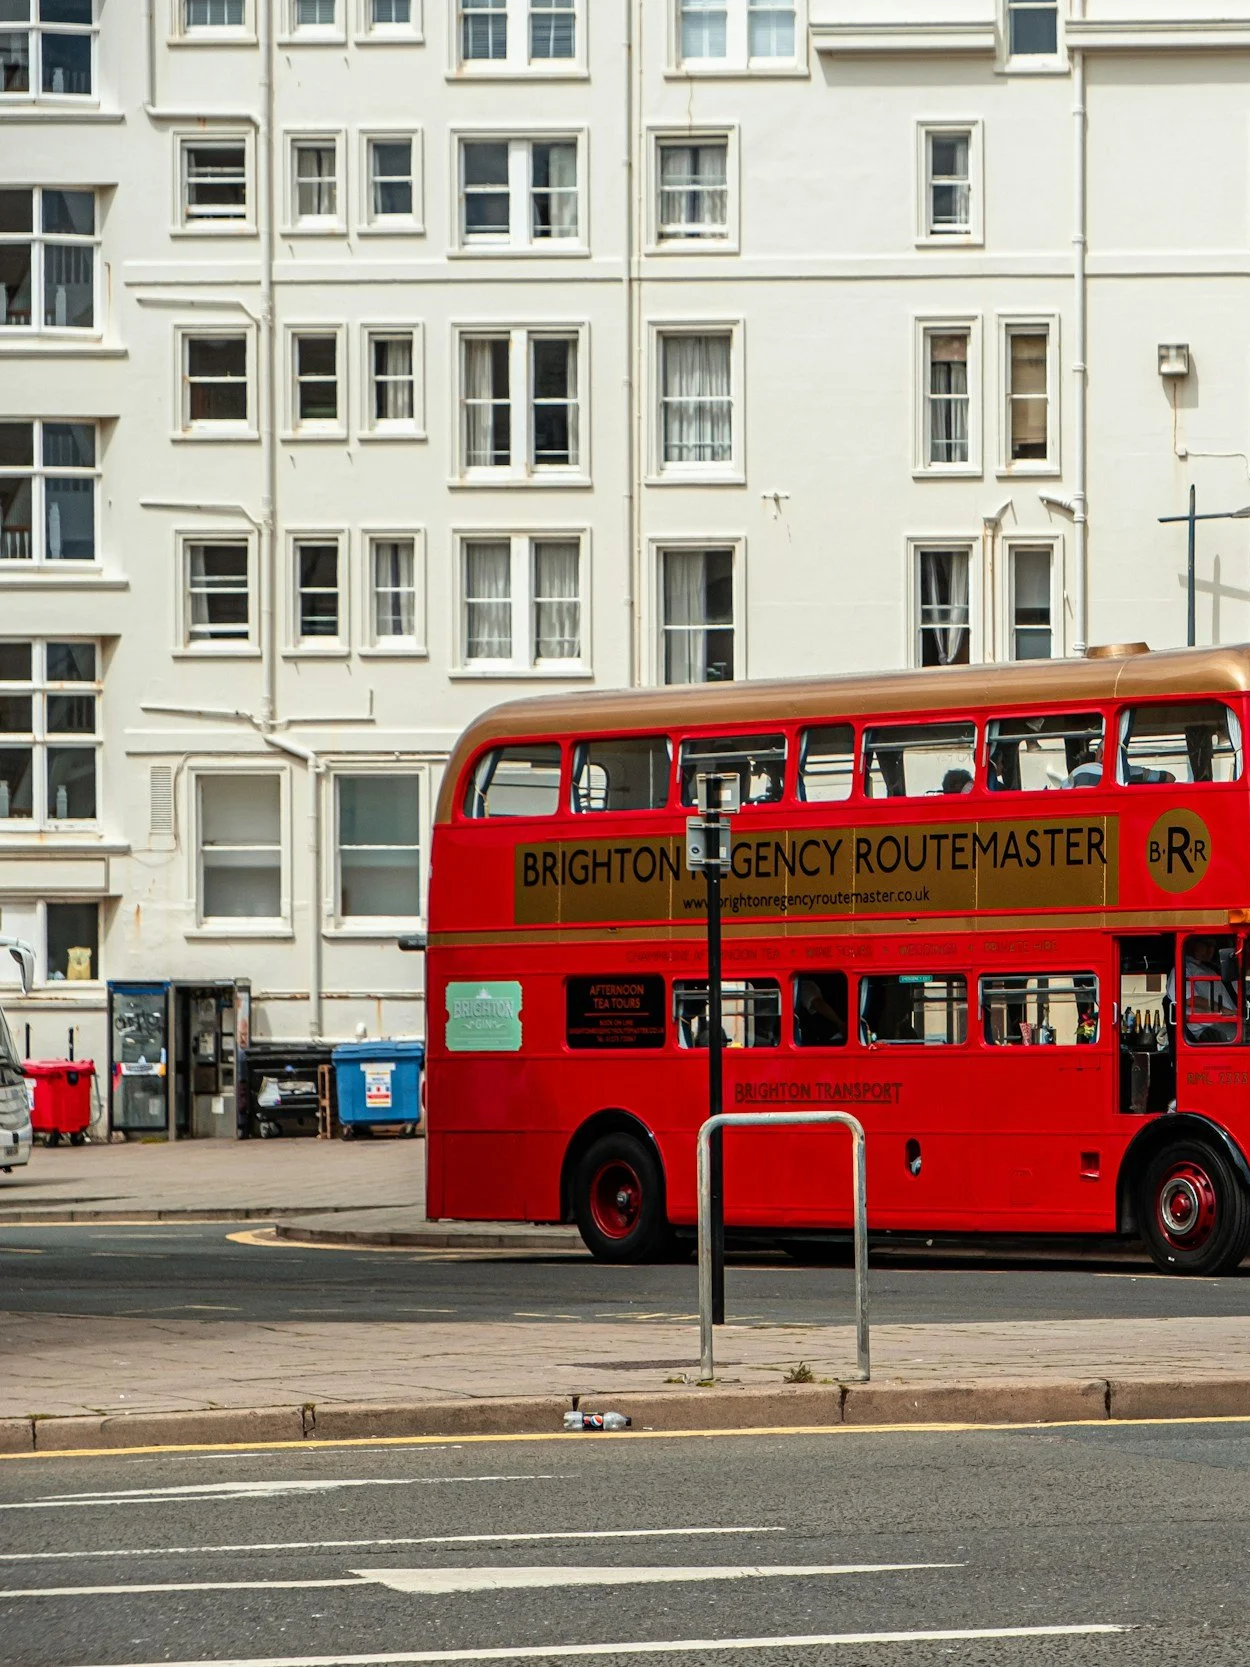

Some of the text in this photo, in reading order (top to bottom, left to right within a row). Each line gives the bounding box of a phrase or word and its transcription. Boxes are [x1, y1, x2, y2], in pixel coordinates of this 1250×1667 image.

[523, 826, 1108, 887] BRIGHTON GENCY ROUTEMASTER
[683, 886, 931, 913] wwrightonregencyroutemaster.co.uk
[589, 983, 645, 995] AFTERNOON
[453, 999, 514, 1020] BRIGHTON
[593, 997, 641, 1009] TEA TOURS
[734, 1081, 905, 1104] BRIGHTON TRANSPORT
